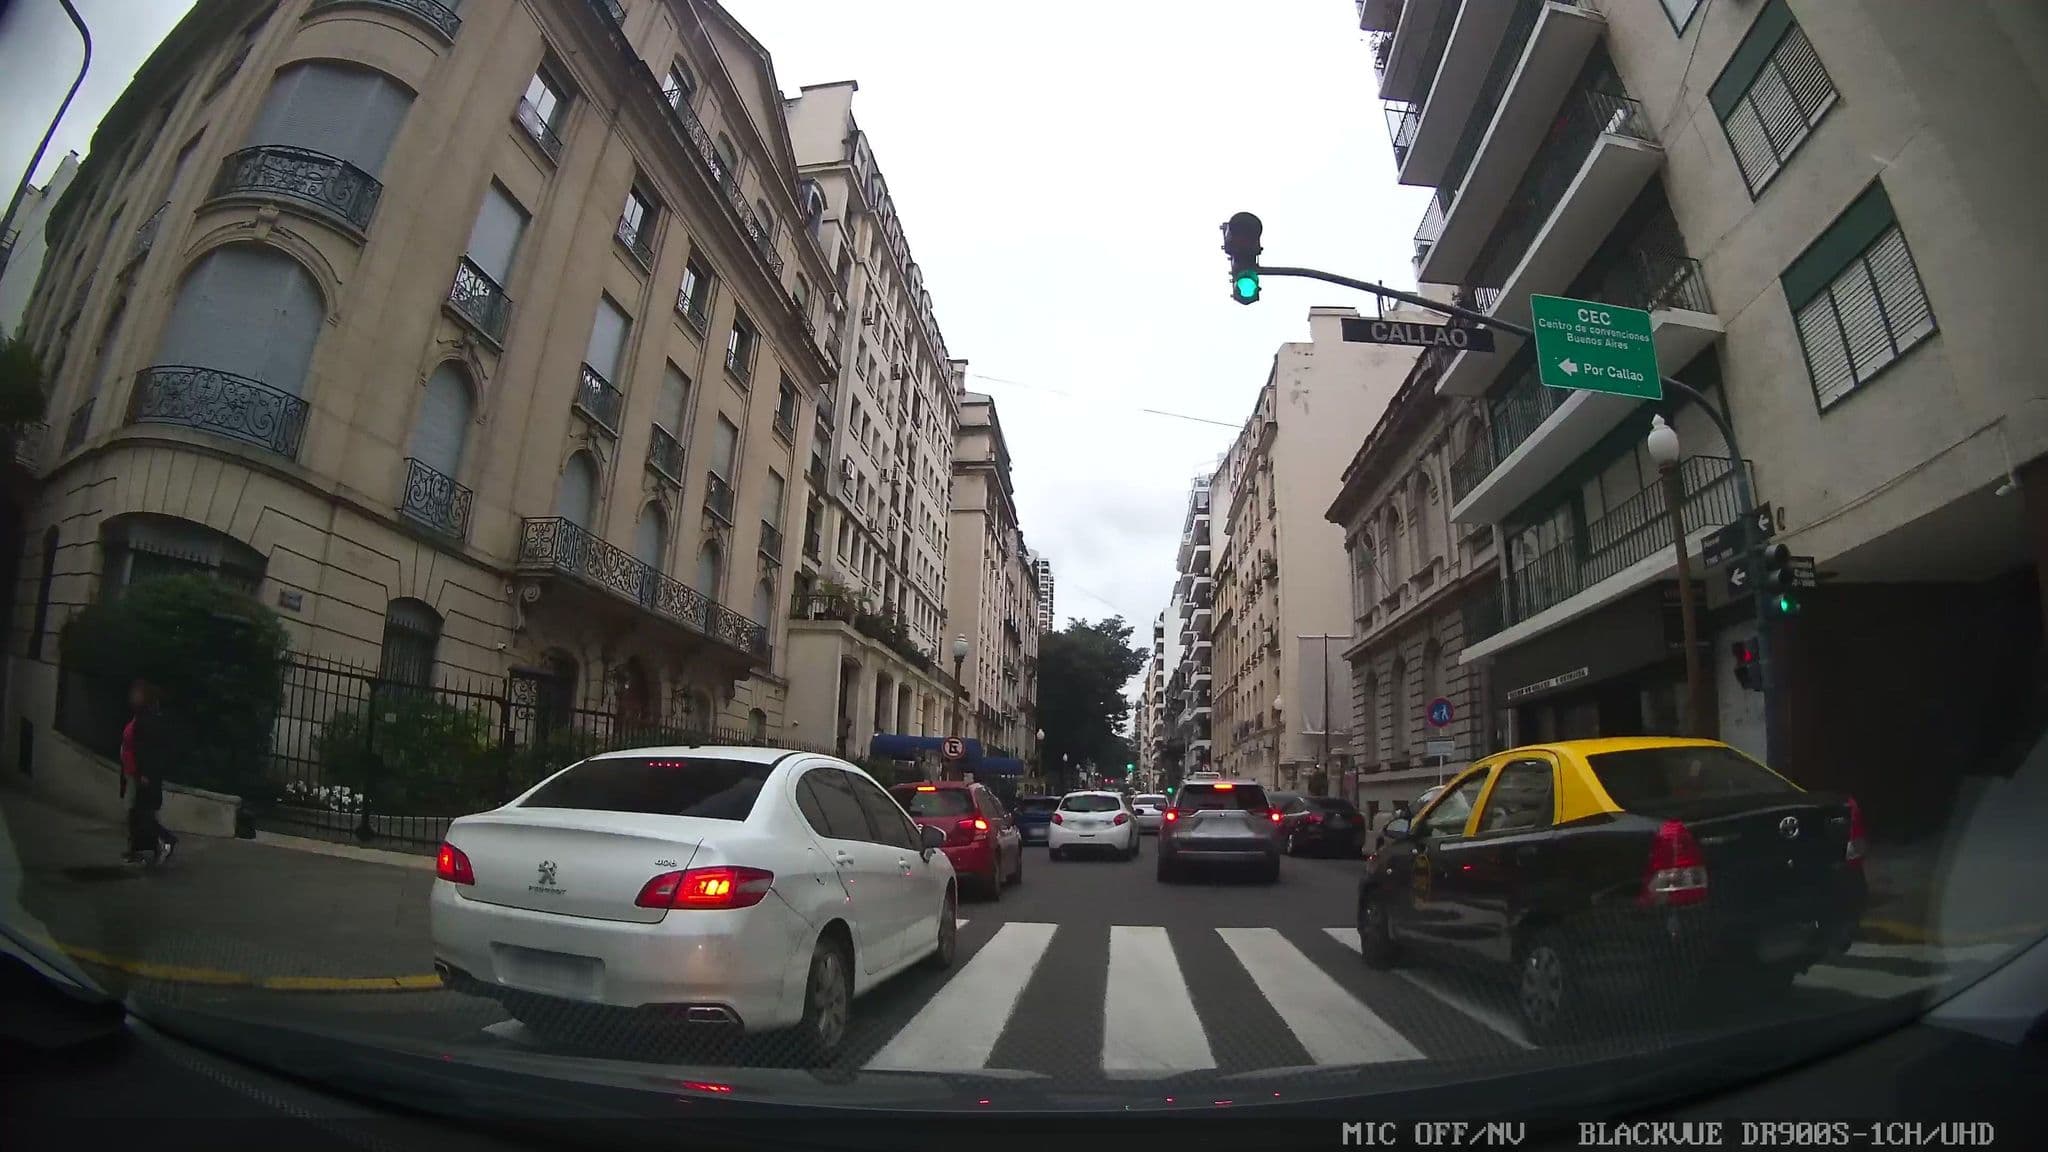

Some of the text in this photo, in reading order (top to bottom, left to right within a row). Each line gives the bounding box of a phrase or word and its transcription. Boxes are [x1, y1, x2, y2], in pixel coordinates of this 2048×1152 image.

[1577, 308, 1611, 326] CEC
[1370, 321, 1468, 348] CALLAO
[1538, 318, 1650, 343] Centro de convenciones
[1566, 332, 1629, 350] Buenos Aires
[1583, 362, 1644, 382] Por Callao
